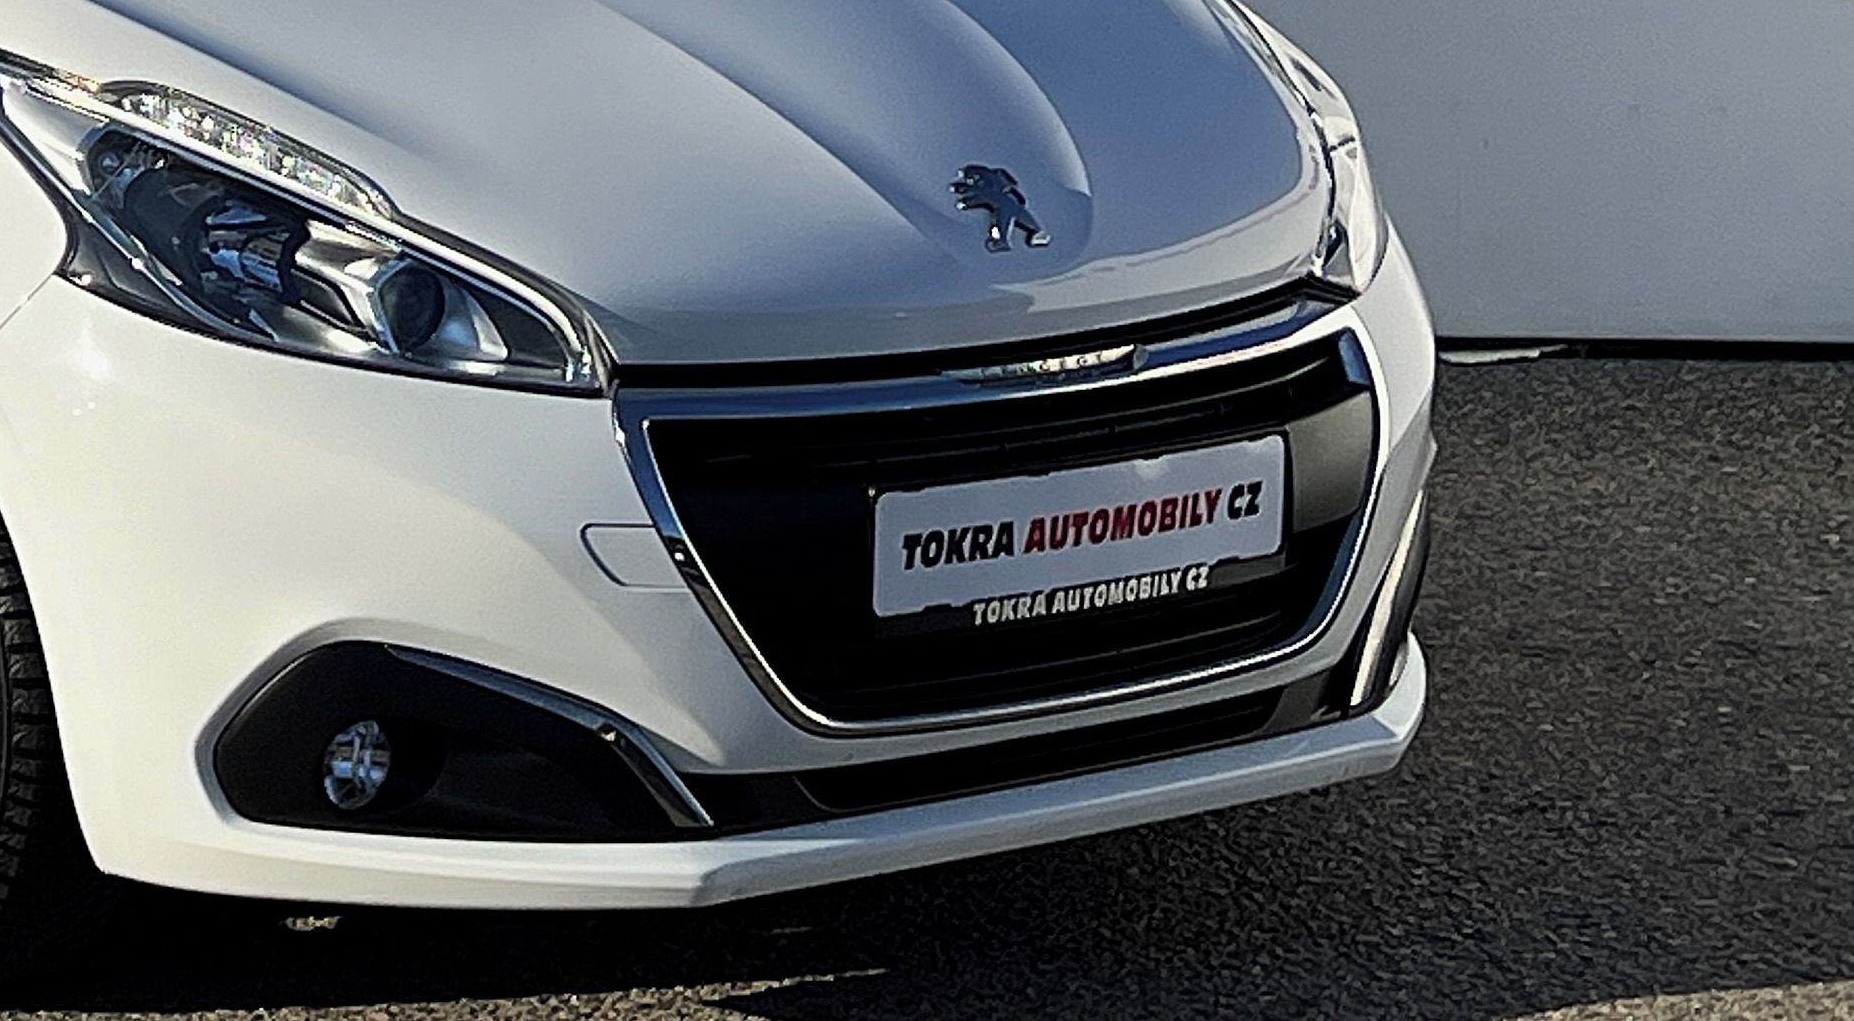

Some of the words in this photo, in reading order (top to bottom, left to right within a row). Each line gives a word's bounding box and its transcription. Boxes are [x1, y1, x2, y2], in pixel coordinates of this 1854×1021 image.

[901, 520, 1015, 571] TOKRA
[1022, 488, 1223, 555] AUTOMOBILY
[1226, 481, 1264, 521] CZ
[973, 591, 1047, 627] TOKRA
[1050, 570, 1183, 615] AUTOMOBILY
[1185, 565, 1211, 592] CZ
